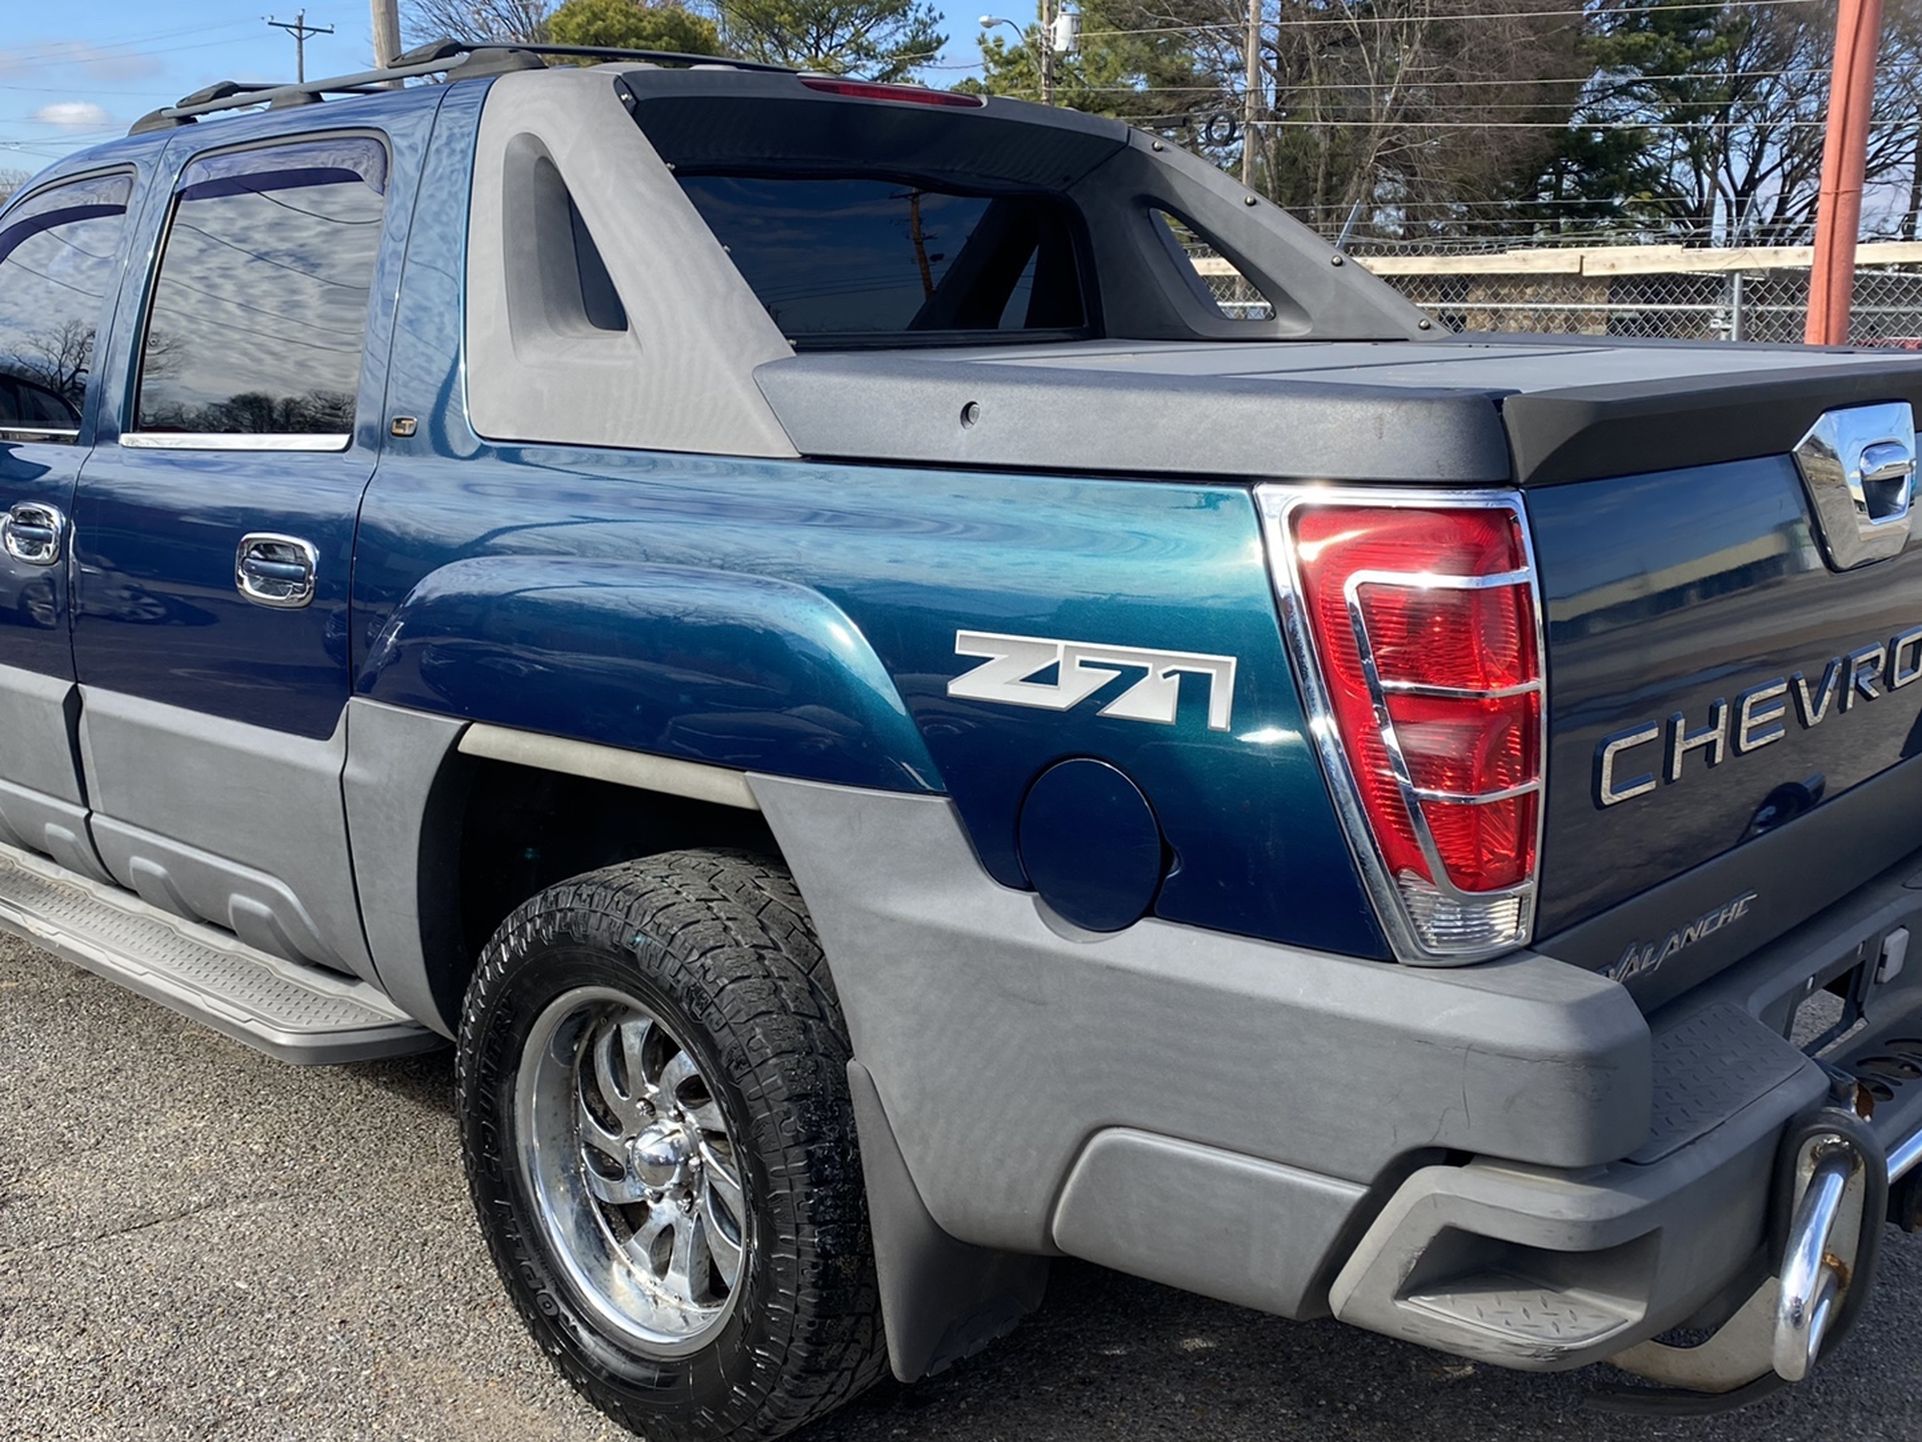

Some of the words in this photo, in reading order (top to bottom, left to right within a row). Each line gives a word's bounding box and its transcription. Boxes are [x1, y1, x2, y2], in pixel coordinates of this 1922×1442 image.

[391, 418, 416, 435] LT
[948, 630, 1237, 731] Z71
[480, 988, 519, 1183] COUNTRY
